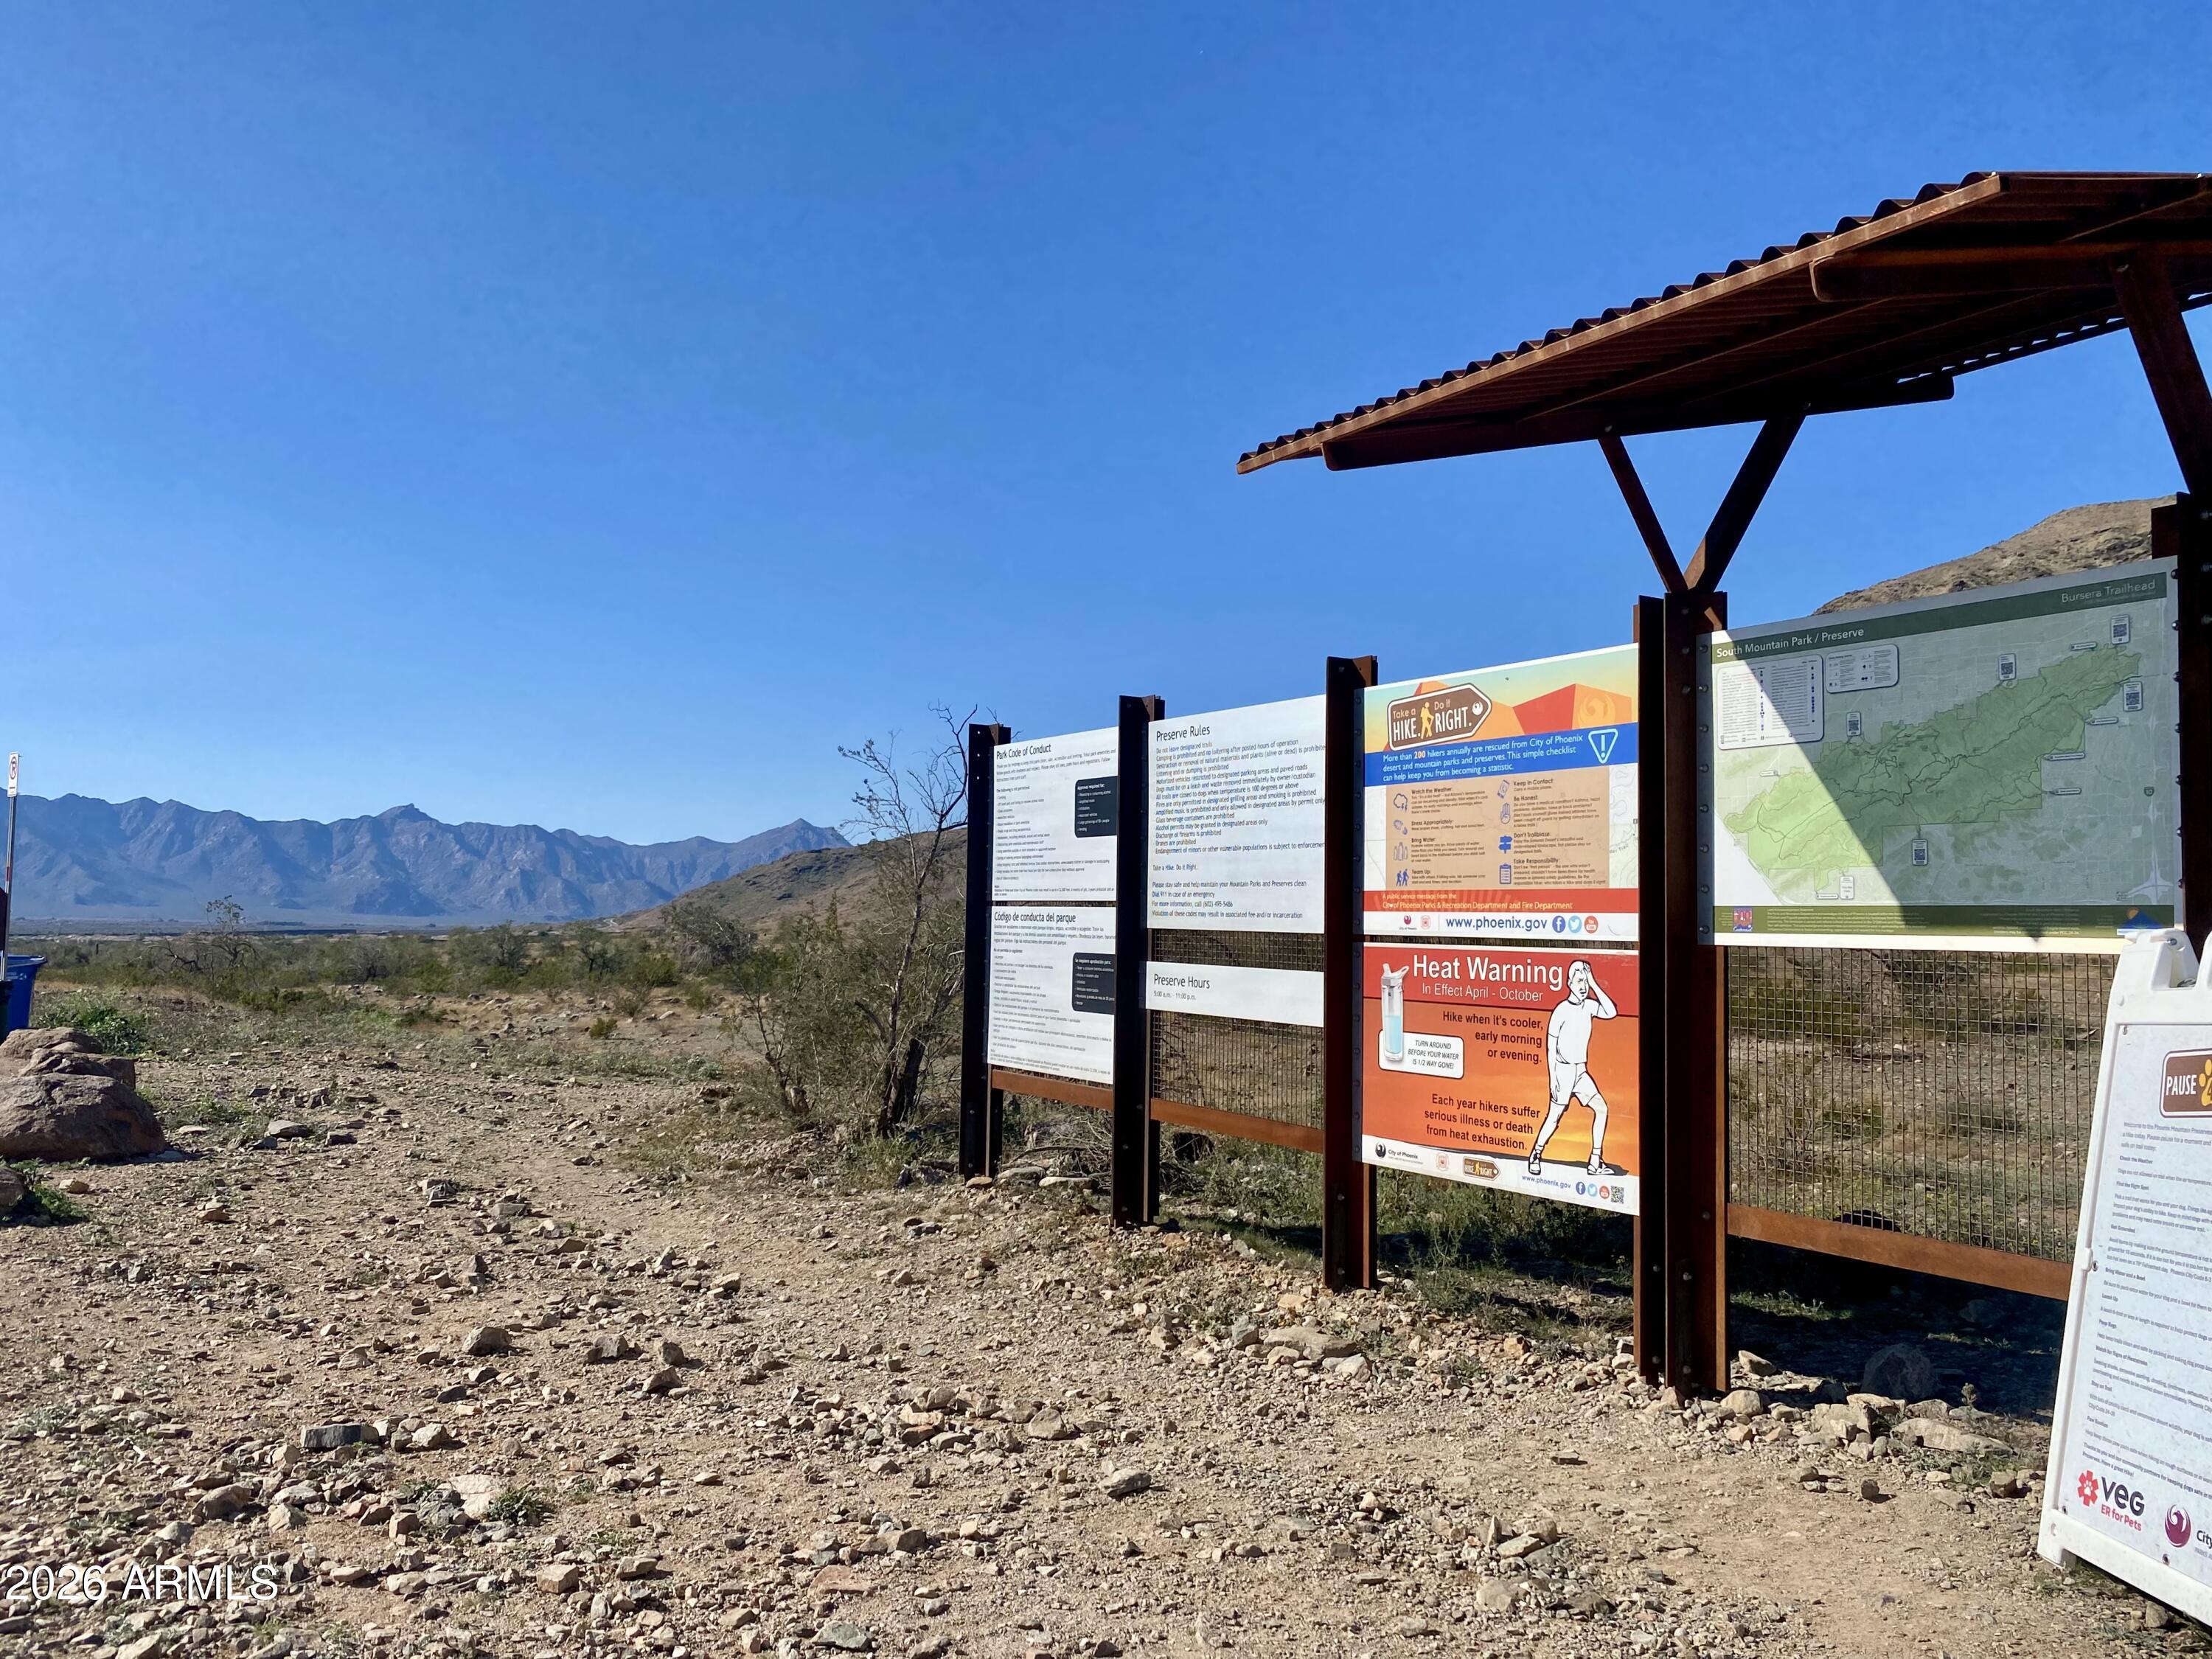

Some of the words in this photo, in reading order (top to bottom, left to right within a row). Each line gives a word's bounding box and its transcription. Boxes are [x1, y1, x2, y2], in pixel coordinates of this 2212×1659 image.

[2062, 590, 2101, 602] Bursera
[2105, 579, 2156, 596] Trailhead
[1717, 644, 1742, 658] South
[1745, 640, 1789, 653] Mountain
[1792, 634, 1812, 647] Park
[1815, 632, 1820, 644] /
[1821, 629, 1865, 641] Preserve
[1434, 701, 1444, 710] Do
[1446, 699, 1450, 708] it
[1393, 709, 1409, 719] Take
[1435, 706, 1472, 733] RIGHT.
[1156, 729, 1187, 742] Preserve
[1190, 725, 1210, 737] Rules
[1393, 717, 1421, 741] HIKE.
[996, 750, 1007, 759] Park
[1009, 748, 1021, 758] Code
[1023, 746, 1028, 756] of
[1029, 743, 1051, 755] Conduct
[1383, 754, 1398, 762] More
[1427, 748, 1445, 757] hikers
[1447, 746, 1471, 756] annually
[1485, 742, 1509, 752] rescued
[1512, 740, 1527, 748] from
[1529, 739, 1544, 748] City
[1545, 737, 1553, 745] of
[1555, 734, 1583, 744] Phoenix
[1382, 763, 1401, 772] desert
[1402, 762, 1413, 771] and
[1414, 760, 1441, 769] mountain
[1443, 758, 1460, 768] parks
[1461, 756, 1473, 764] and
[1474, 754, 1506, 765] preserves.
[1507, 751, 1521, 760] This
[1523, 749, 1544, 759] simple
[1546, 746, 1576, 756] checklist
[1394, 772, 1406, 782] help
[1408, 771, 1421, 781] keep
[1422, 771, 1434, 779] you
[1435, 768, 1450, 776] from
[1451, 765, 1481, 775] becoming
[1220, 787, 1245, 796] temperature
[1472, 902, 1508, 911] Department
[1534, 902, 1573, 911] Department
[994, 911, 1012, 923] Código
[1012, 912, 1019, 921] de
[1020, 913, 1044, 922] conducta
[1046, 912, 1054, 922] del
[1056, 914, 1076, 924] parque
[1446, 916, 1547, 931] www.phoenix.gov
[1154, 973, 1186, 987] Preserve
[1188, 976, 1210, 989] Hours
[1413, 954, 1461, 979] Heat
[1467, 956, 1563, 992] Warning
[1422, 982, 1430, 995] In
[1435, 983, 1463, 997] Effect
[1465, 984, 1489, 1001] April
[1499, 987, 1543, 1002] October
[1443, 1011, 1463, 1023] Hike
[1466, 1014, 1489, 1025] when
[1493, 1015, 1507, 1026] it's
[1510, 1017, 1543, 1031] cooler,
[1429, 1041, 1452, 1050] AROUND
[1475, 1031, 1498, 1044] early
[1501, 1034, 1543, 1048] morning
[1408, 1048, 1427, 1057] BEFORE
[1487, 1049, 1498, 1057] or
[1500, 1050, 1542, 1065] evening.
[2166, 1074, 2197, 1096] PAUSE
[1432, 1093, 1454, 1106] Each
[1456, 1098, 1476, 1110] year
[1479, 1099, 1509, 1114] hikers
[1512, 1105, 1540, 1119] suffer
[1425, 1110, 1457, 1123] serious
[1460, 1113, 1490, 1128] illness
[1493, 1121, 1503, 1130] or
[1506, 1121, 1534, 1134] death
[1427, 1124, 1447, 1137] from
[1450, 1127, 1470, 1141] heat
[1472, 1133, 1527, 1150] exhaustion.
[1402, 1152, 1418, 1160] Phoenix
[1522, 1175, 1571, 1189] www.phoenix.gov
[2101, 1504, 2111, 1517] ER
[2112, 1509, 2124, 1522] for
[2124, 1515, 2142, 1531] Pets
